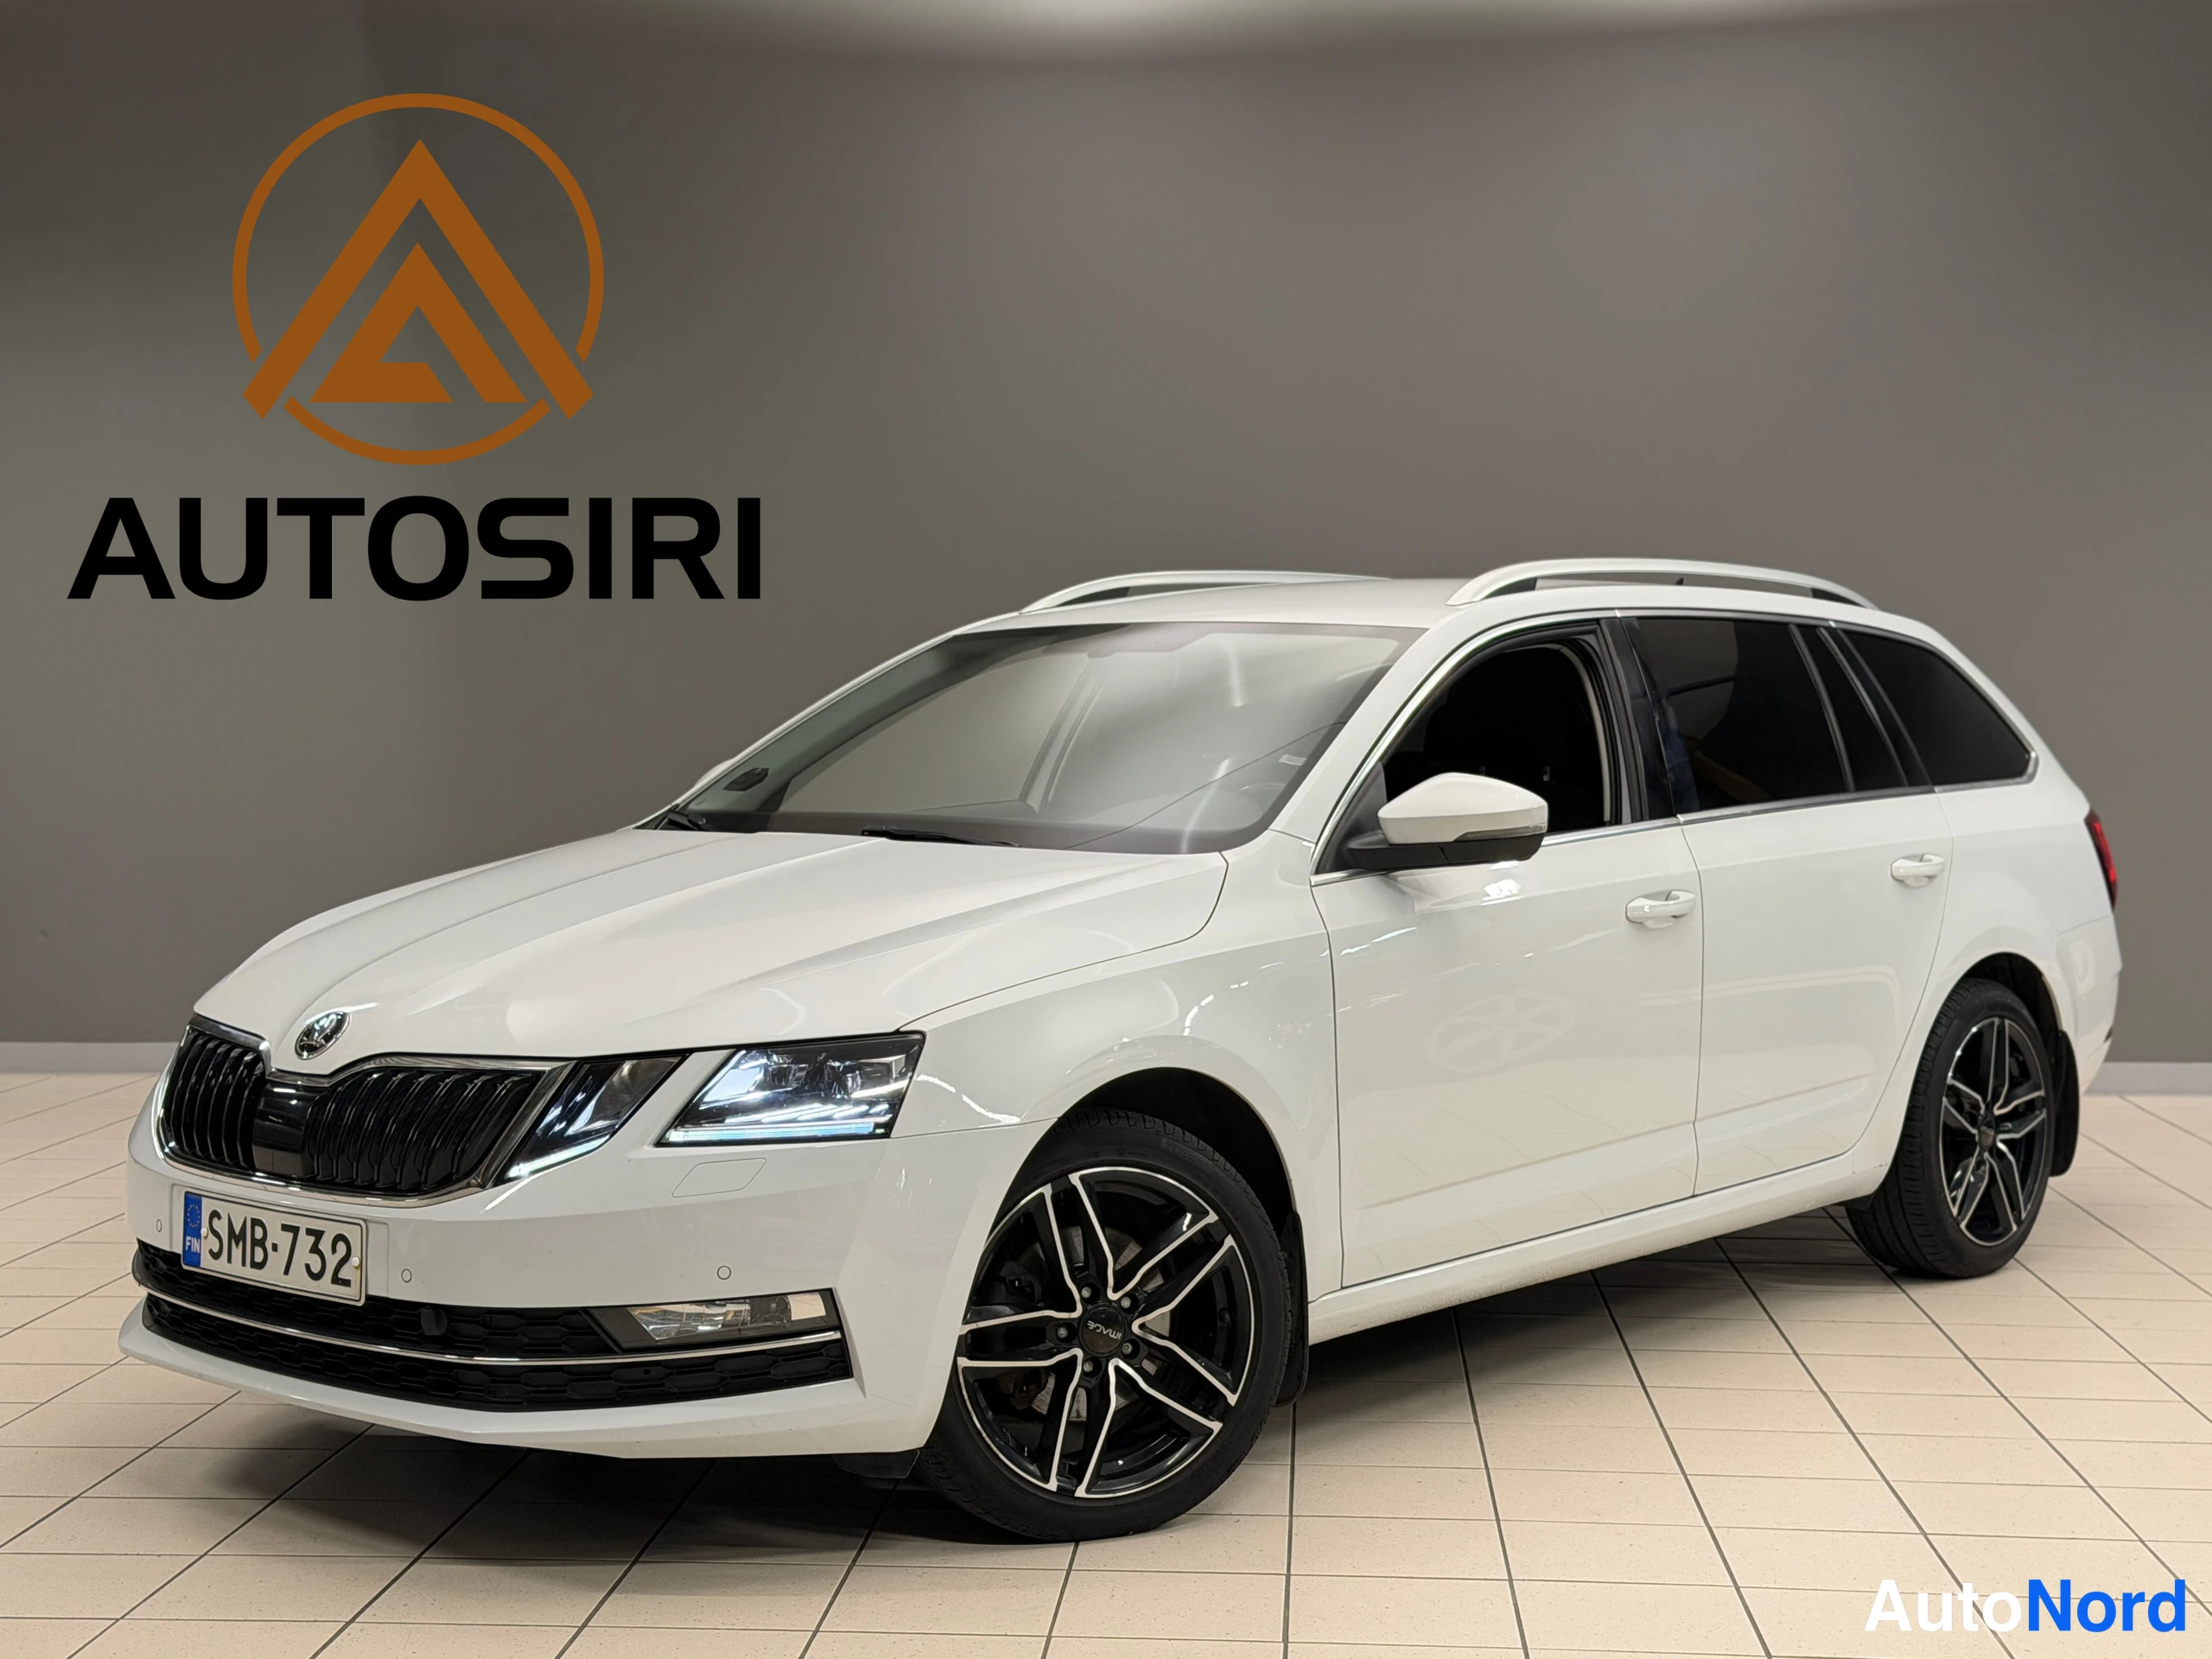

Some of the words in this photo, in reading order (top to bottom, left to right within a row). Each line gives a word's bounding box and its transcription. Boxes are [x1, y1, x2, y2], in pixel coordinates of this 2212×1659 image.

[185, 1236, 200, 1254] FIN
[207, 1209, 352, 1287] SMB-732
[1086, 1319, 1122, 1340] IMAGE
